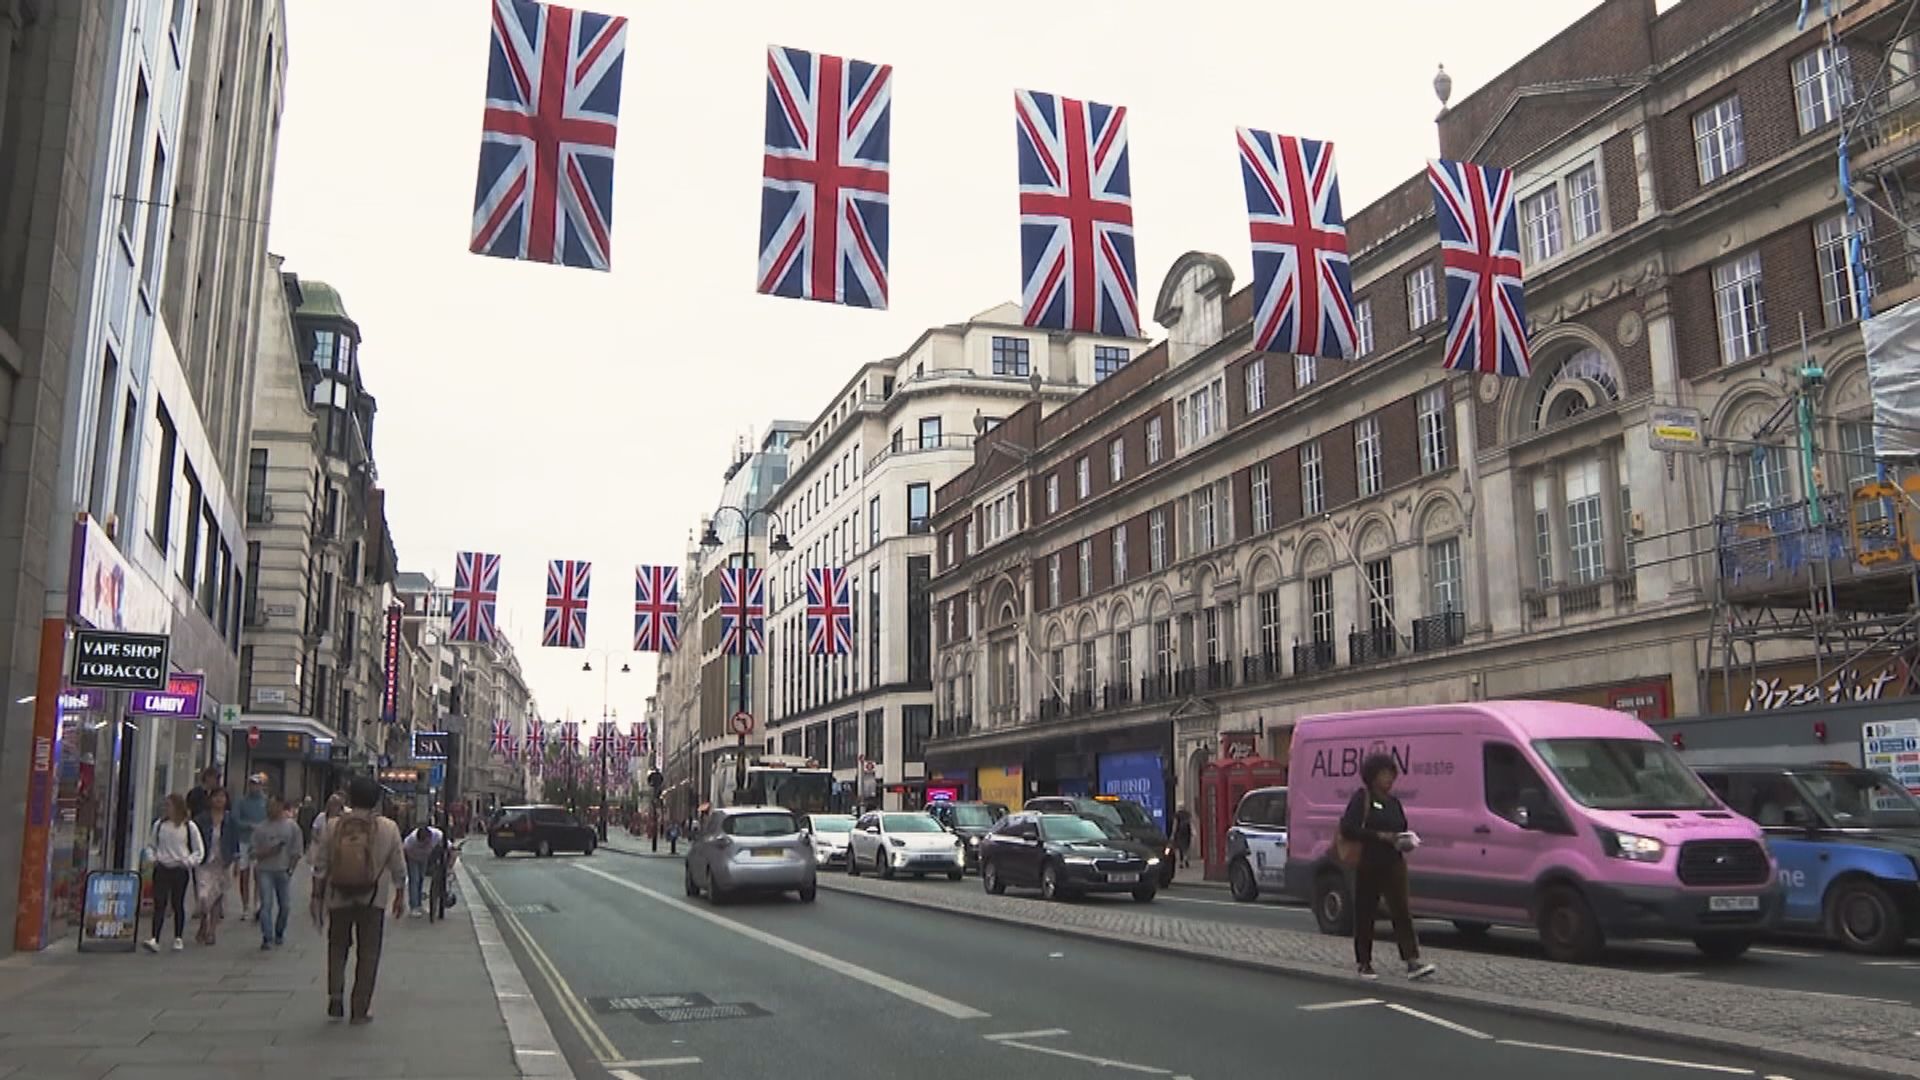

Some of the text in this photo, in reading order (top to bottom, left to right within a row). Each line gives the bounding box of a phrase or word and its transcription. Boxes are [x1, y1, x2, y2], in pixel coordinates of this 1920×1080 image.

[83, 641, 162, 659] VAPE SHOP
[80, 662, 160, 680] TOBACCO
[1744, 677, 1821, 711] Pizza
[144, 695, 186, 713] CANDY
[1412, 760, 1455, 776] waste
[1778, 868, 1805, 887] ne
